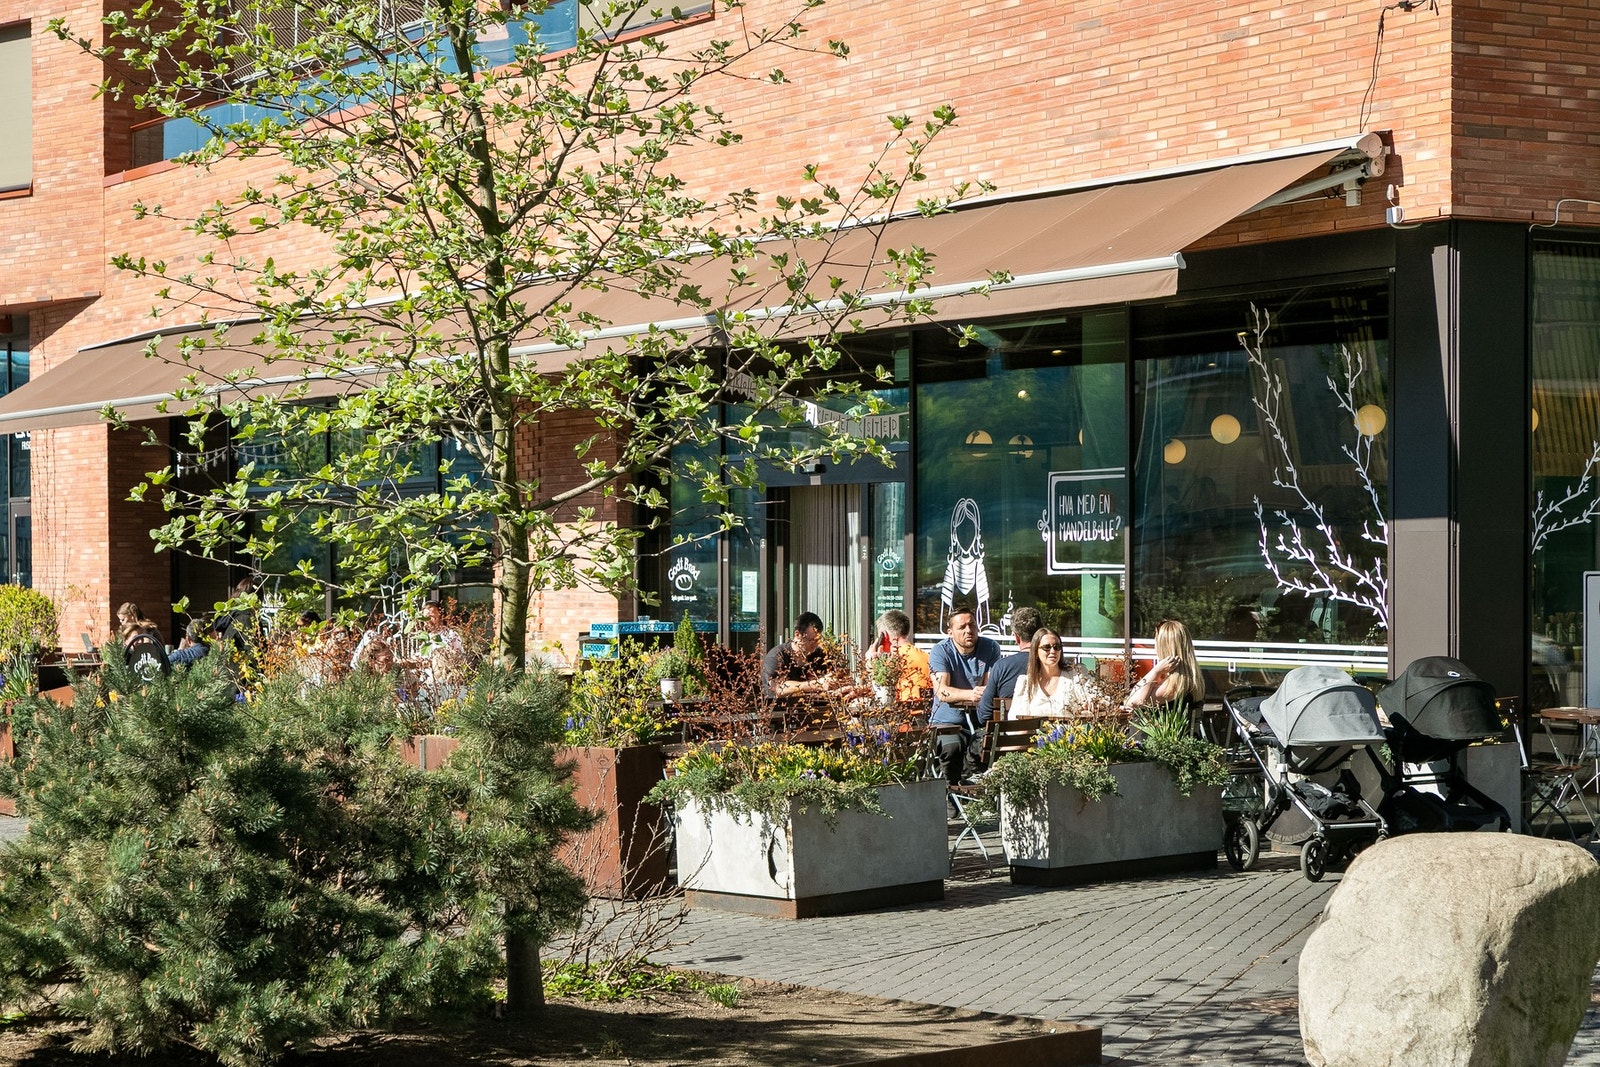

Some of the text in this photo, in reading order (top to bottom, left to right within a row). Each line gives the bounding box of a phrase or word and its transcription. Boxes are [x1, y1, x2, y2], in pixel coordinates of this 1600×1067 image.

[1059, 494, 1111, 516] HVA MED EN
[668, 557, 683, 581] Godt
